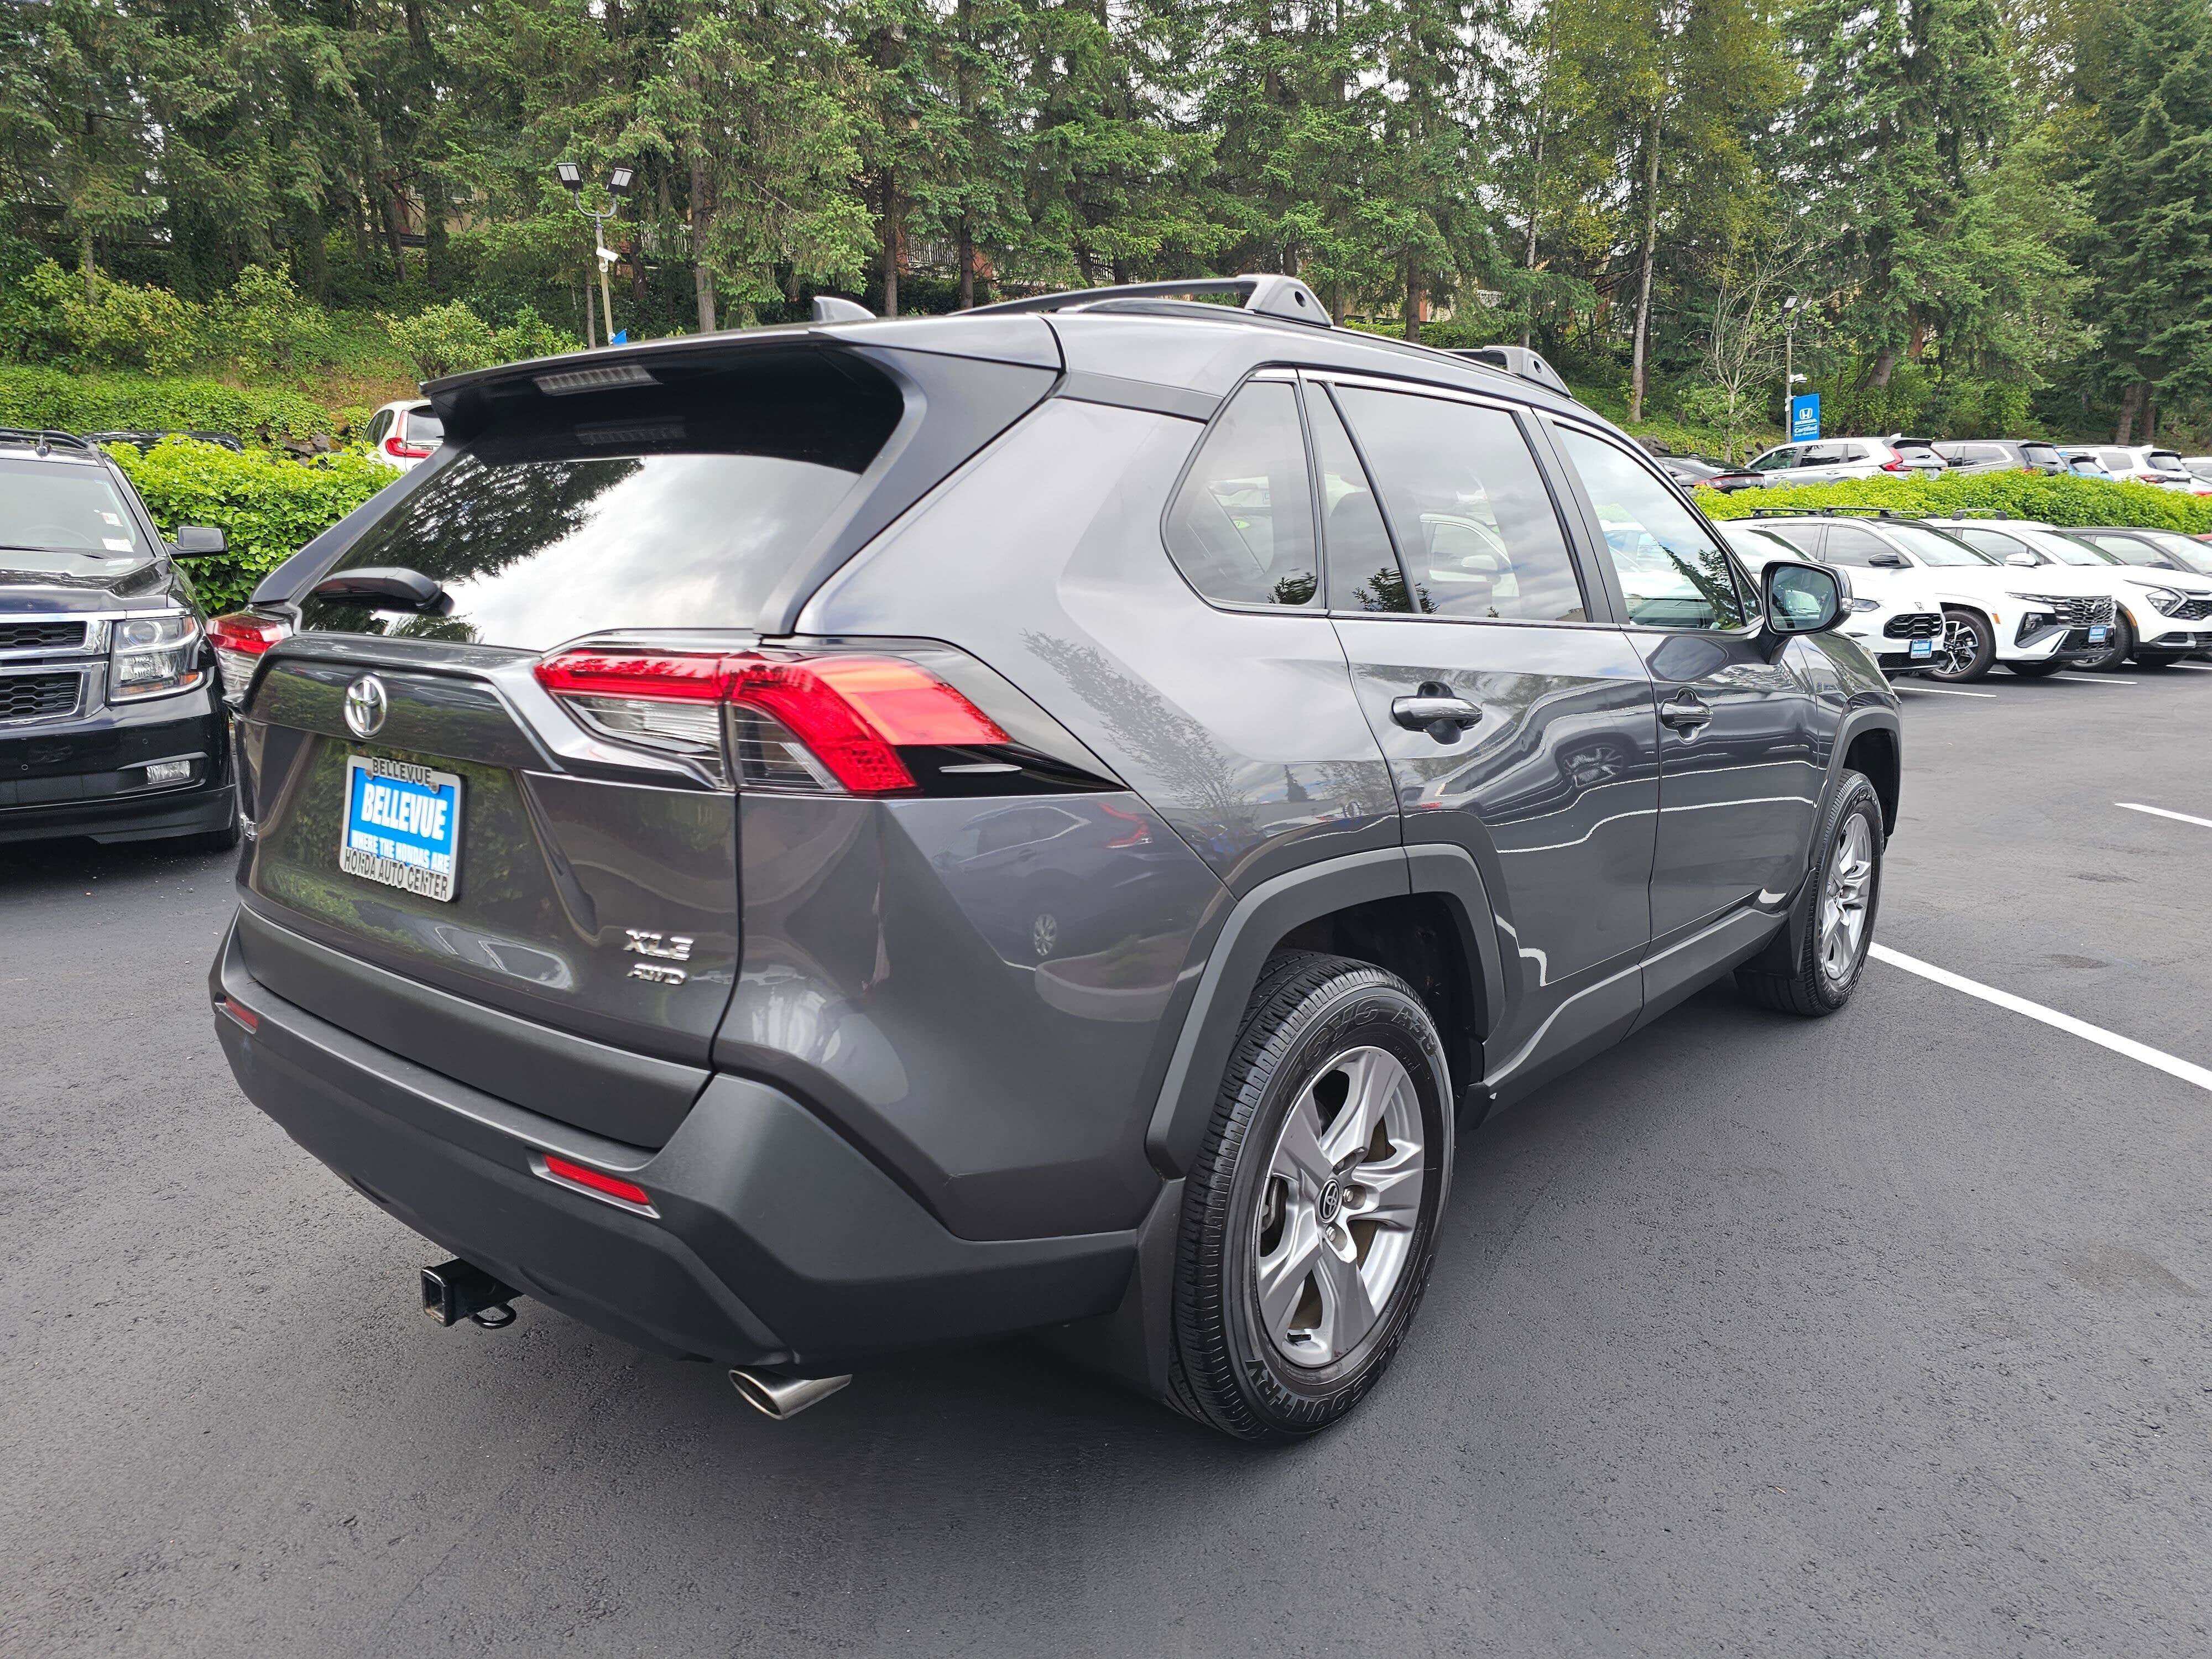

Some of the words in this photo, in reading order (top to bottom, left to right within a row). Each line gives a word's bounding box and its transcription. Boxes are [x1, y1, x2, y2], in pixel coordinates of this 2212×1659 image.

[372, 758, 431, 785] BELLEVUE
[361, 782, 448, 841] BELLEVUE
[351, 830, 379, 855] WHERE
[379, 837, 395, 858] THE
[395, 841, 430, 869] HONDAS
[431, 851, 451, 874] ARE
[345, 849, 375, 879] HONDA
[378, 858, 404, 886] AUTO
[407, 867, 448, 900] CENTER
[623, 930, 694, 961] XLE
[626, 963, 687, 985] AWD
